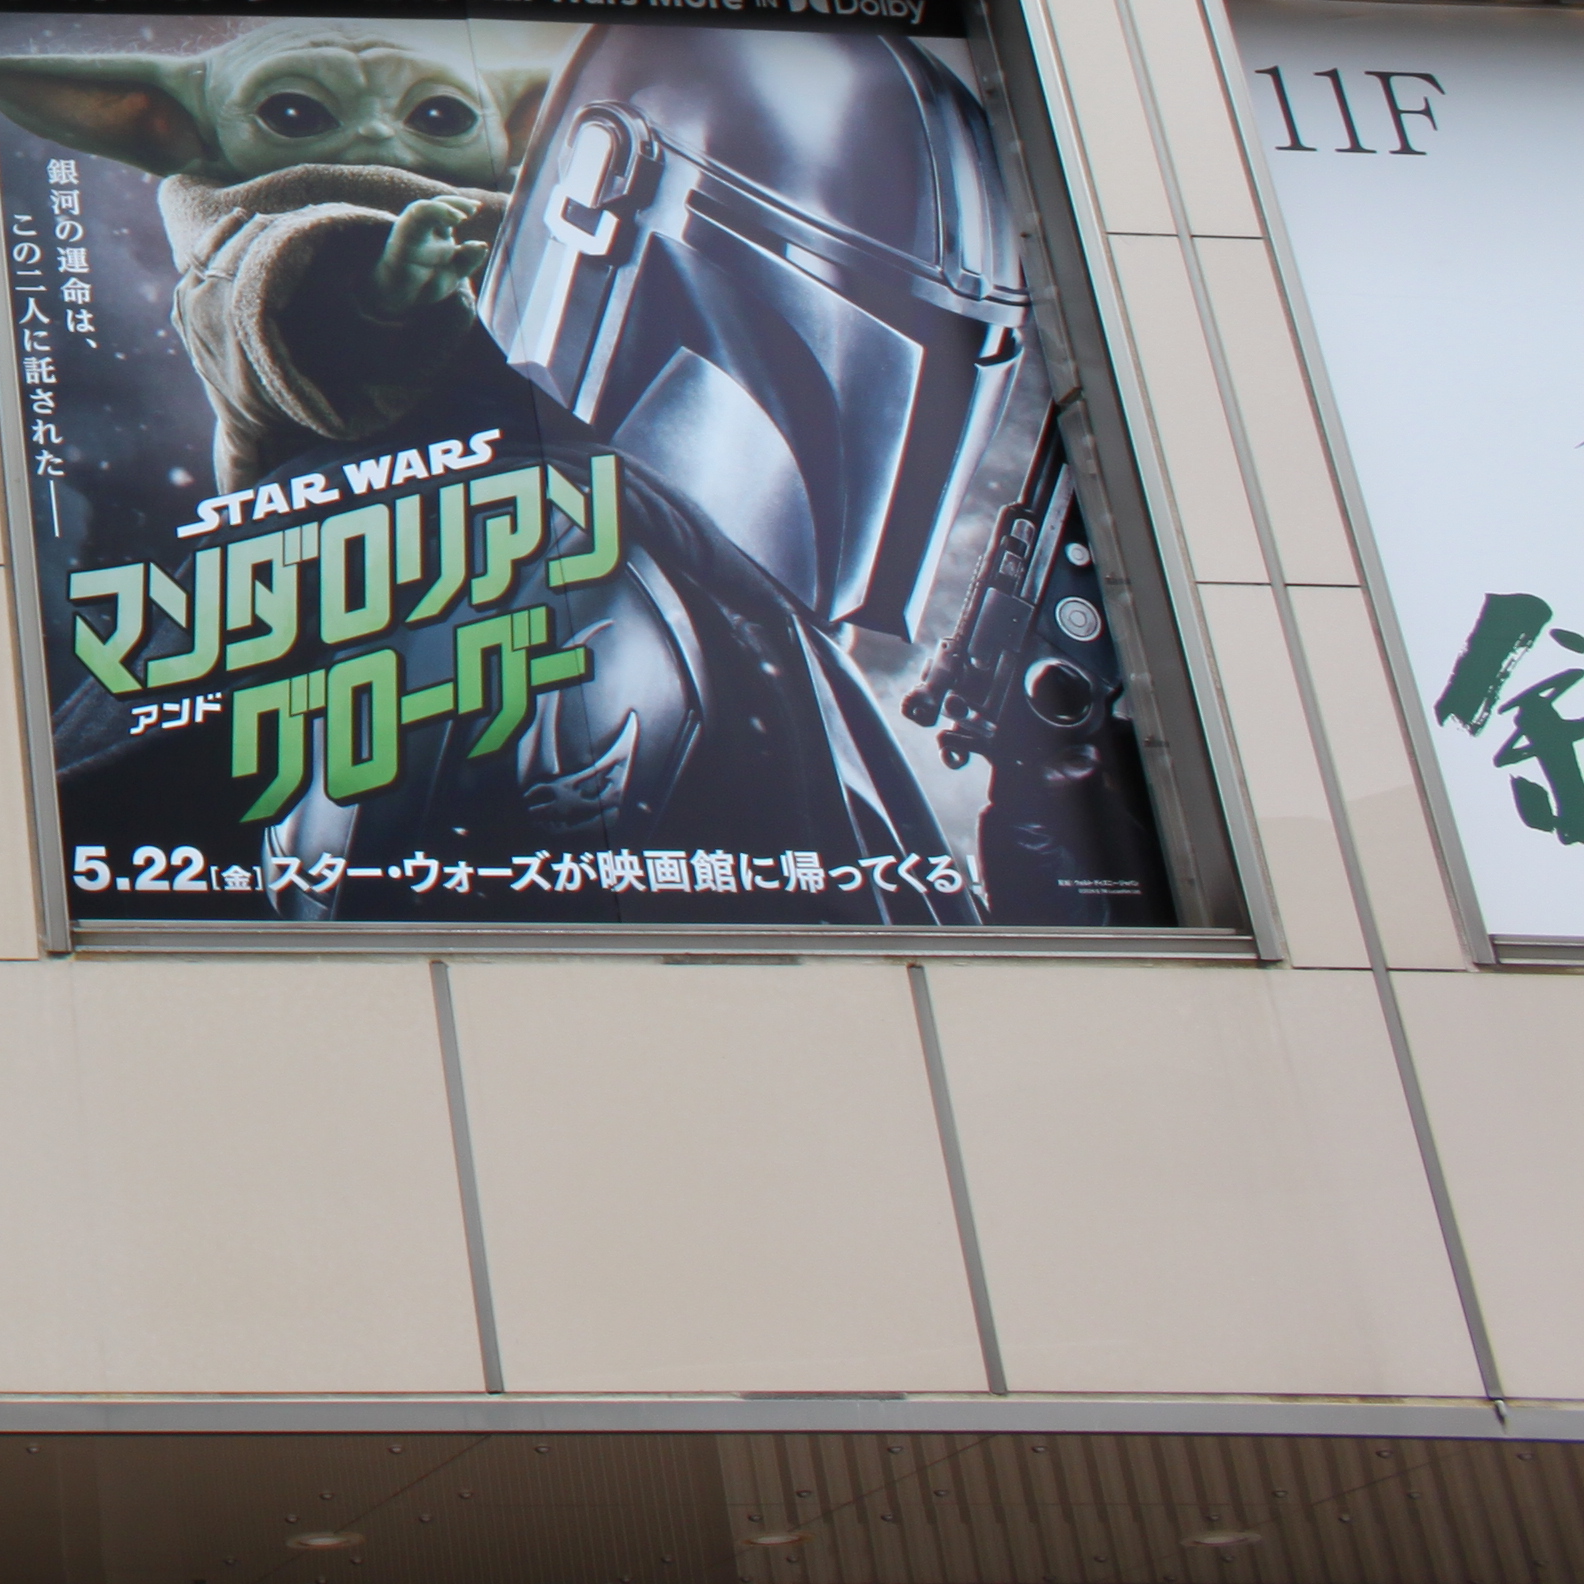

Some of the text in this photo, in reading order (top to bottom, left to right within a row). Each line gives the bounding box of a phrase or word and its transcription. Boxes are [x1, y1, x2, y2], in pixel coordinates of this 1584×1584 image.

[1254, 65, 1446, 156] 11F
[45, 158, 98, 349] 銀河の運命は、
[176, 428, 500, 539] STAR WARS
[68, 453, 621, 696] マンダロリアン
[130, 692, 223, 735] アンド
[230, 605, 586, 823] グローグー
